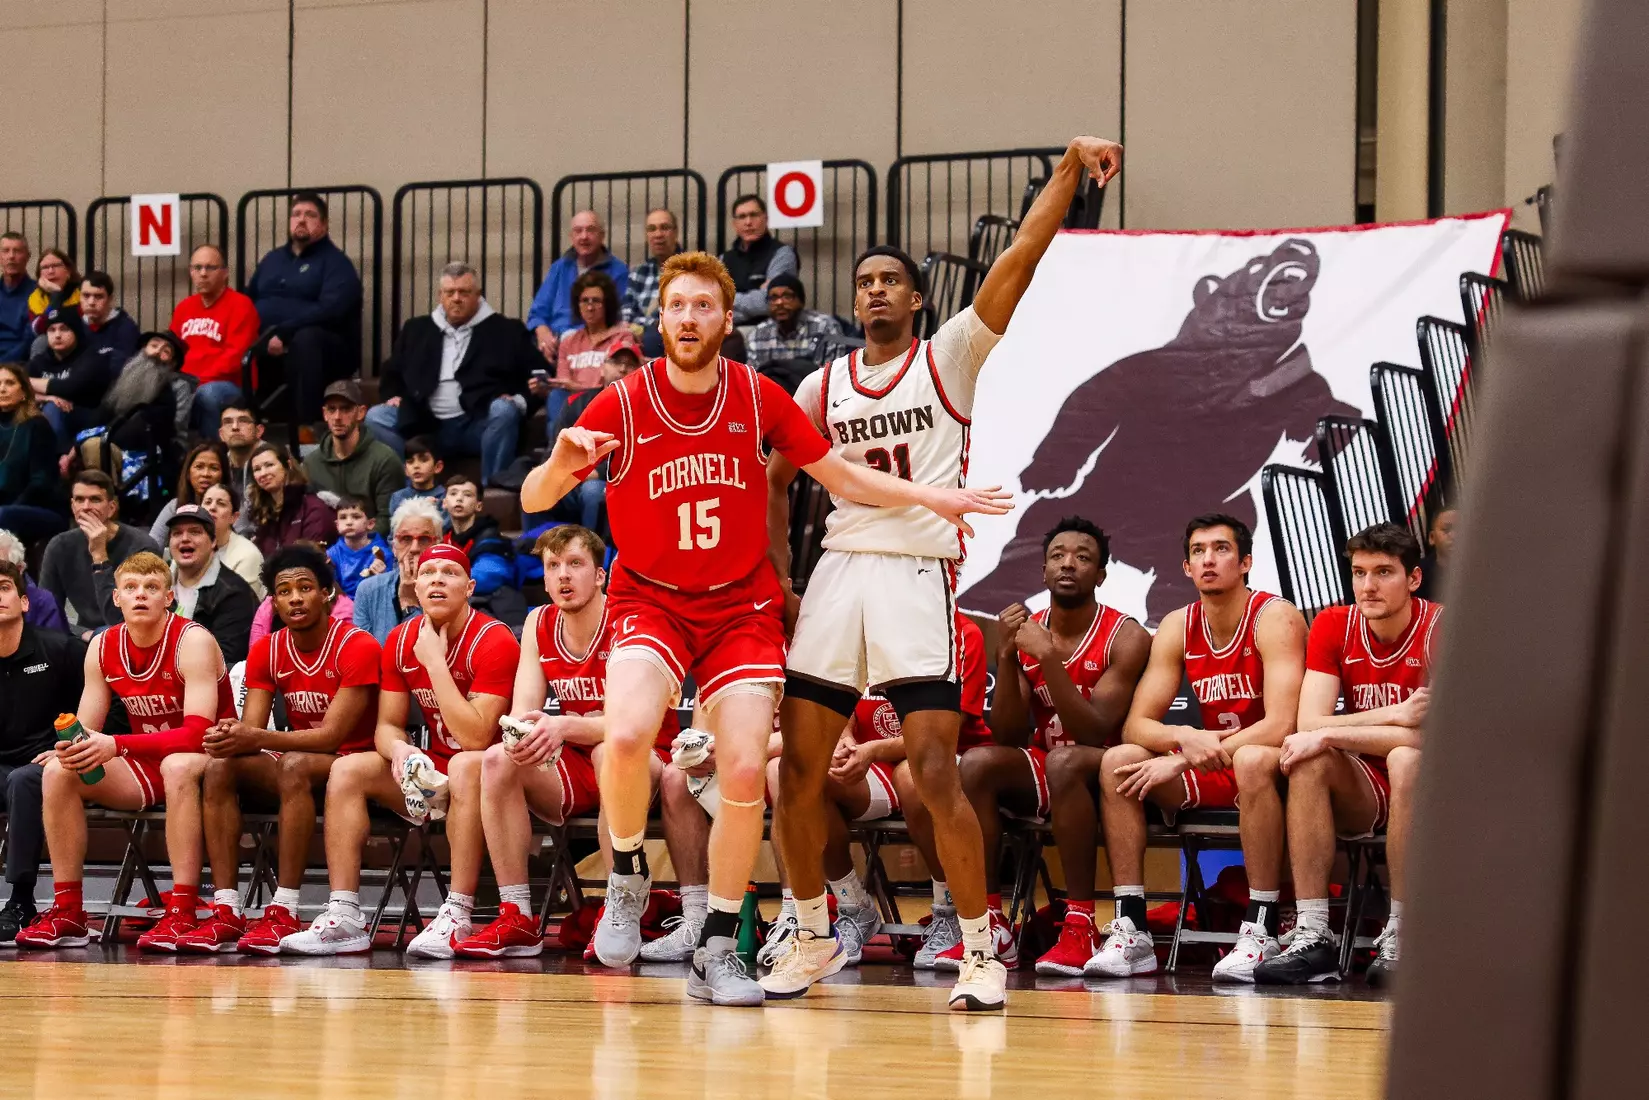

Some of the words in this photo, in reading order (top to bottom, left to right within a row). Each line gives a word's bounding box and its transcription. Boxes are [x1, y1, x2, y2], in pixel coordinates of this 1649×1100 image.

[774, 171, 816, 218] O
[139, 203, 173, 246] N
[833, 404, 934, 444] BROWN
[648, 453, 747, 500] CORNELL
[677, 497, 721, 550] 15
[121, 694, 184, 717] ORNELL
[284, 690, 331, 714] CORNEL
[549, 676, 606, 701] ORNEL
[1191, 672, 1262, 704] CORNELL
